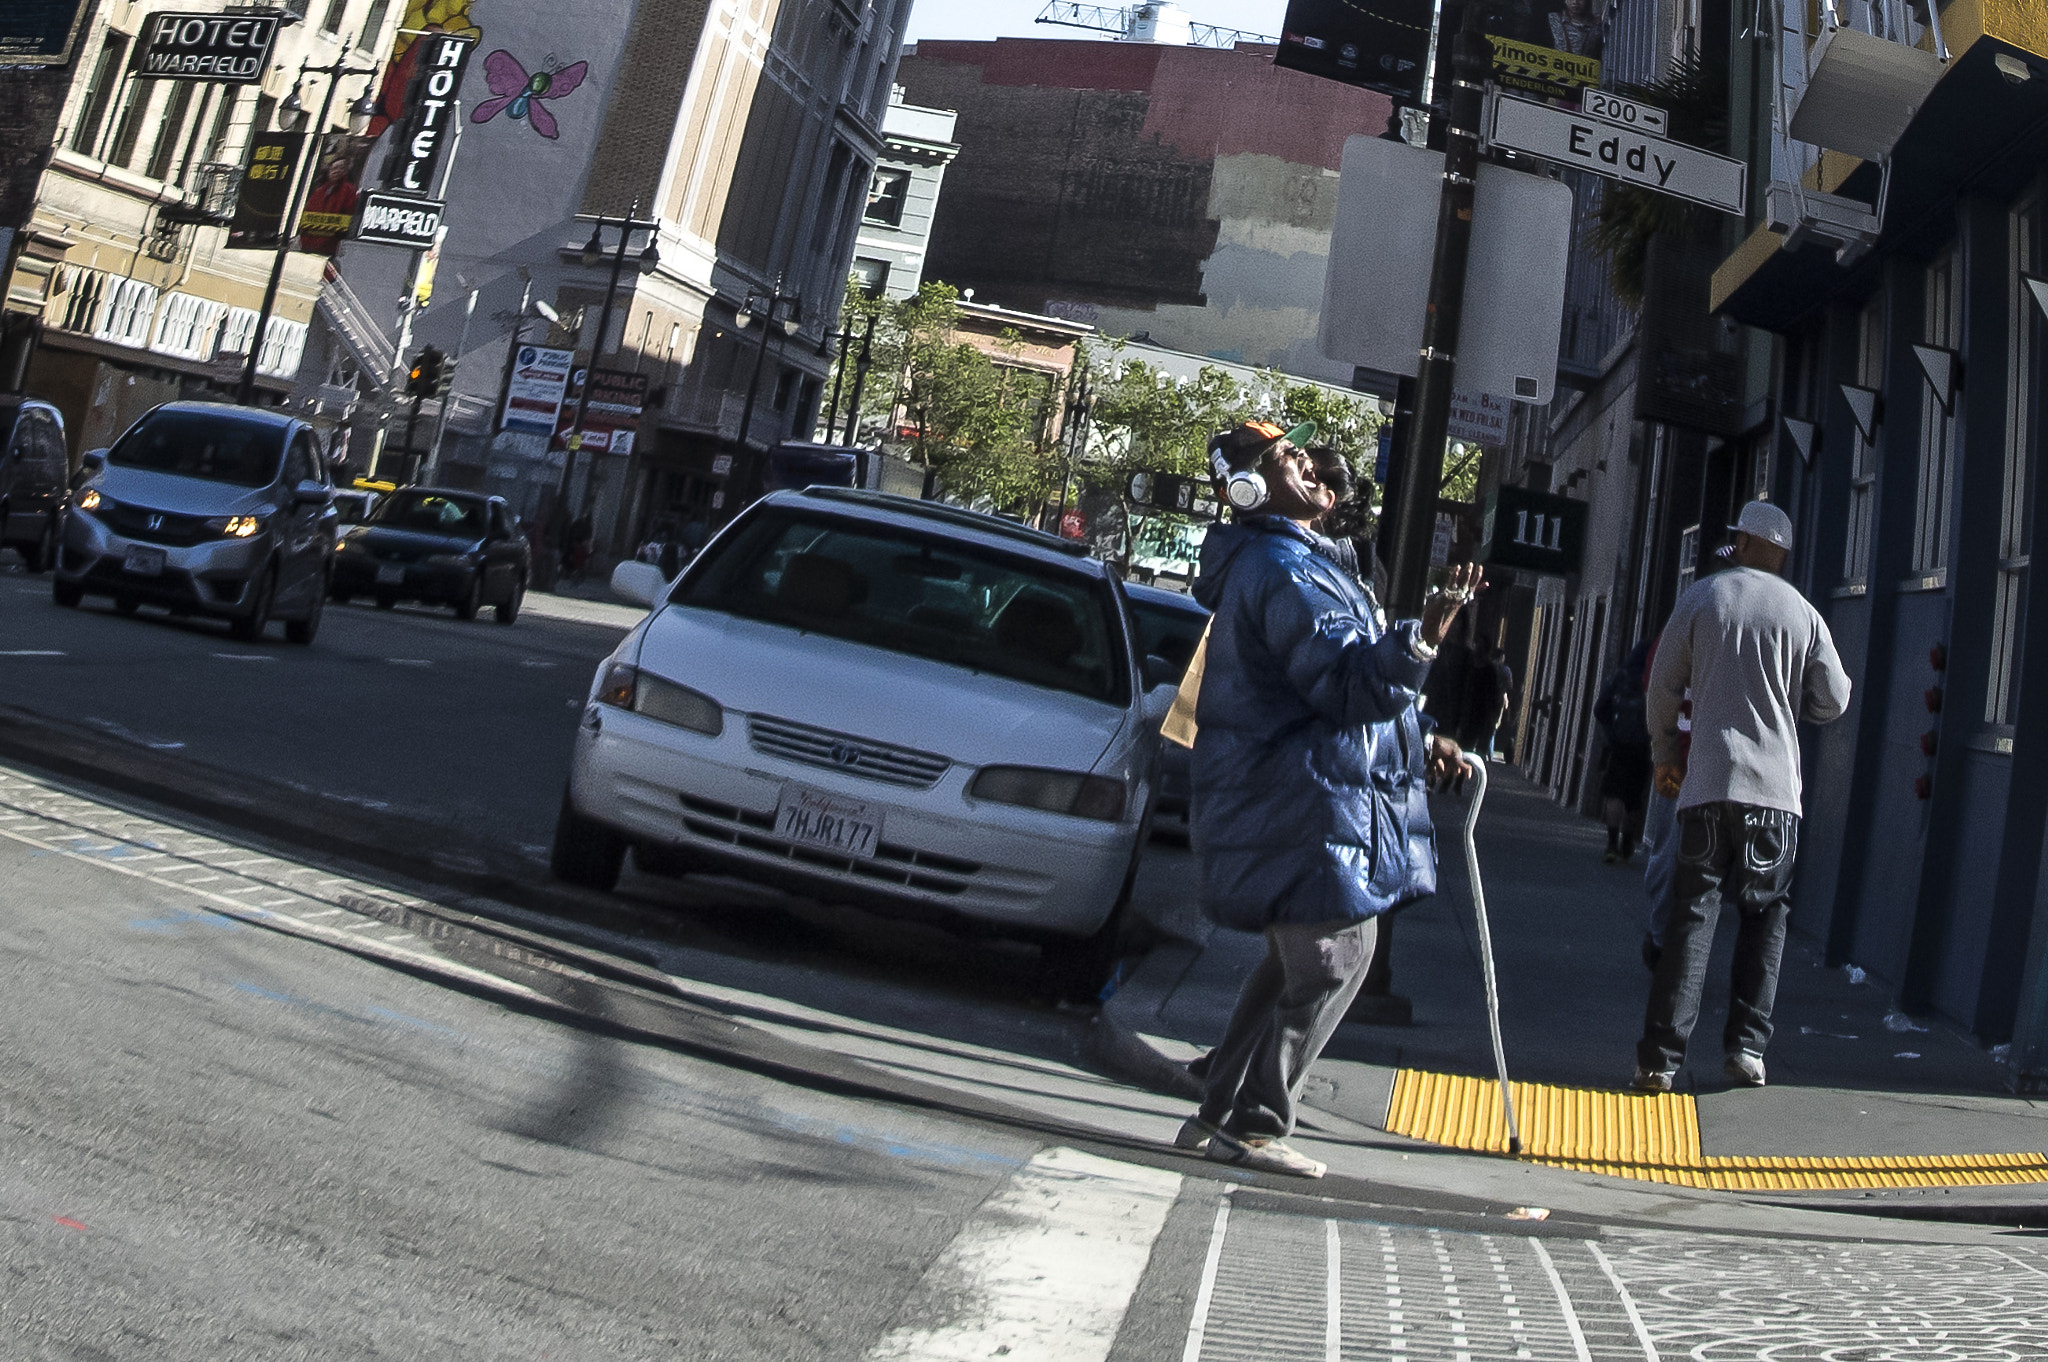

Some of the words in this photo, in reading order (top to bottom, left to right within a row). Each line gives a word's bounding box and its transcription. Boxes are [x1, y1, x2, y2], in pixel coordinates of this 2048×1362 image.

[153, 18, 266, 47] HOTEL
[147, 53, 258, 74] WARFIELD
[1499, 75, 1568, 97] TENDERLOIN
[403, 40, 465, 189] HOTEL
[1592, 95, 1637, 123] 200
[1568, 123, 1677, 187] Eddy
[362, 205, 439, 237] WARFIELD
[572, 386, 641, 406] PRKING
[593, 373, 646, 390] PUBLIC
[1513, 510, 1562, 552] 111
[785, 805, 874, 850] 7HJR177
